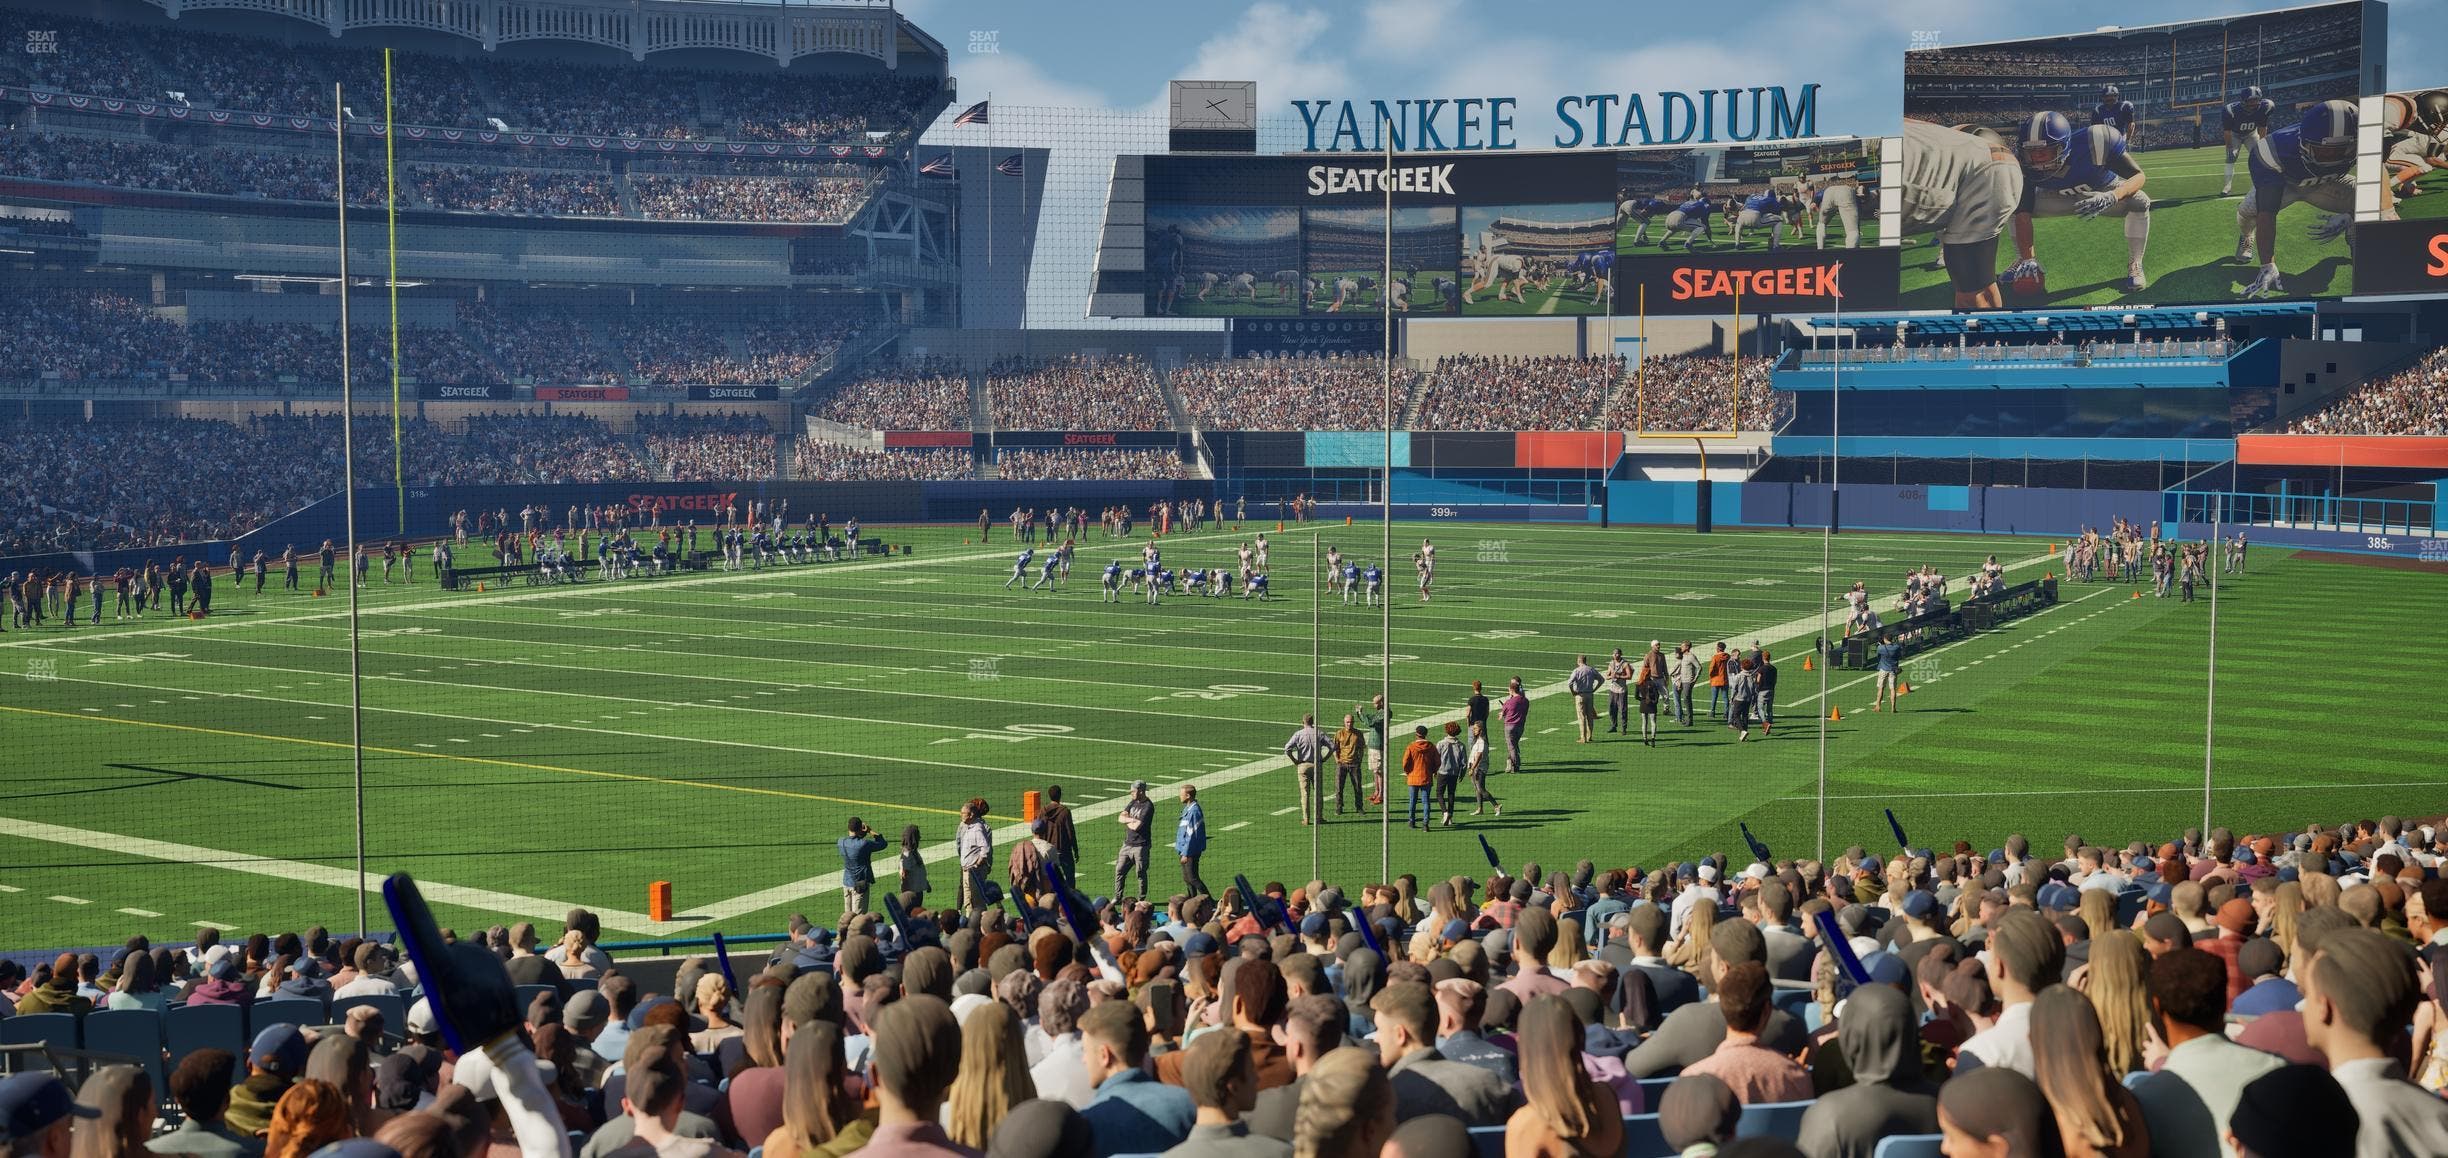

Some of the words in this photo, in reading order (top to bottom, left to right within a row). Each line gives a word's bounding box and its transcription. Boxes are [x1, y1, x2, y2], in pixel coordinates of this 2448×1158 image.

[1291, 97, 1517, 152] YANKEE
[1555, 83, 1822, 148] STADIUM
[1820, 160, 1856, 171] SEATGEEK
[1307, 163, 1456, 196] SEATGEEK
[1672, 262, 1844, 301] SEATGEEK
[1281, 335, 1298, 344] New
[1299, 335, 1318, 346] York
[440, 386, 489, 398] SEATGEEK
[558, 389, 607, 400] SEATGEEK
[709, 387, 757, 398] SEATGEEK
[1064, 433, 1117, 445] SEATGEEK
[627, 492, 738, 514] SEATGEEK
[1170, 684, 1270, 700] 20
[964, 723, 1075, 743] 10
